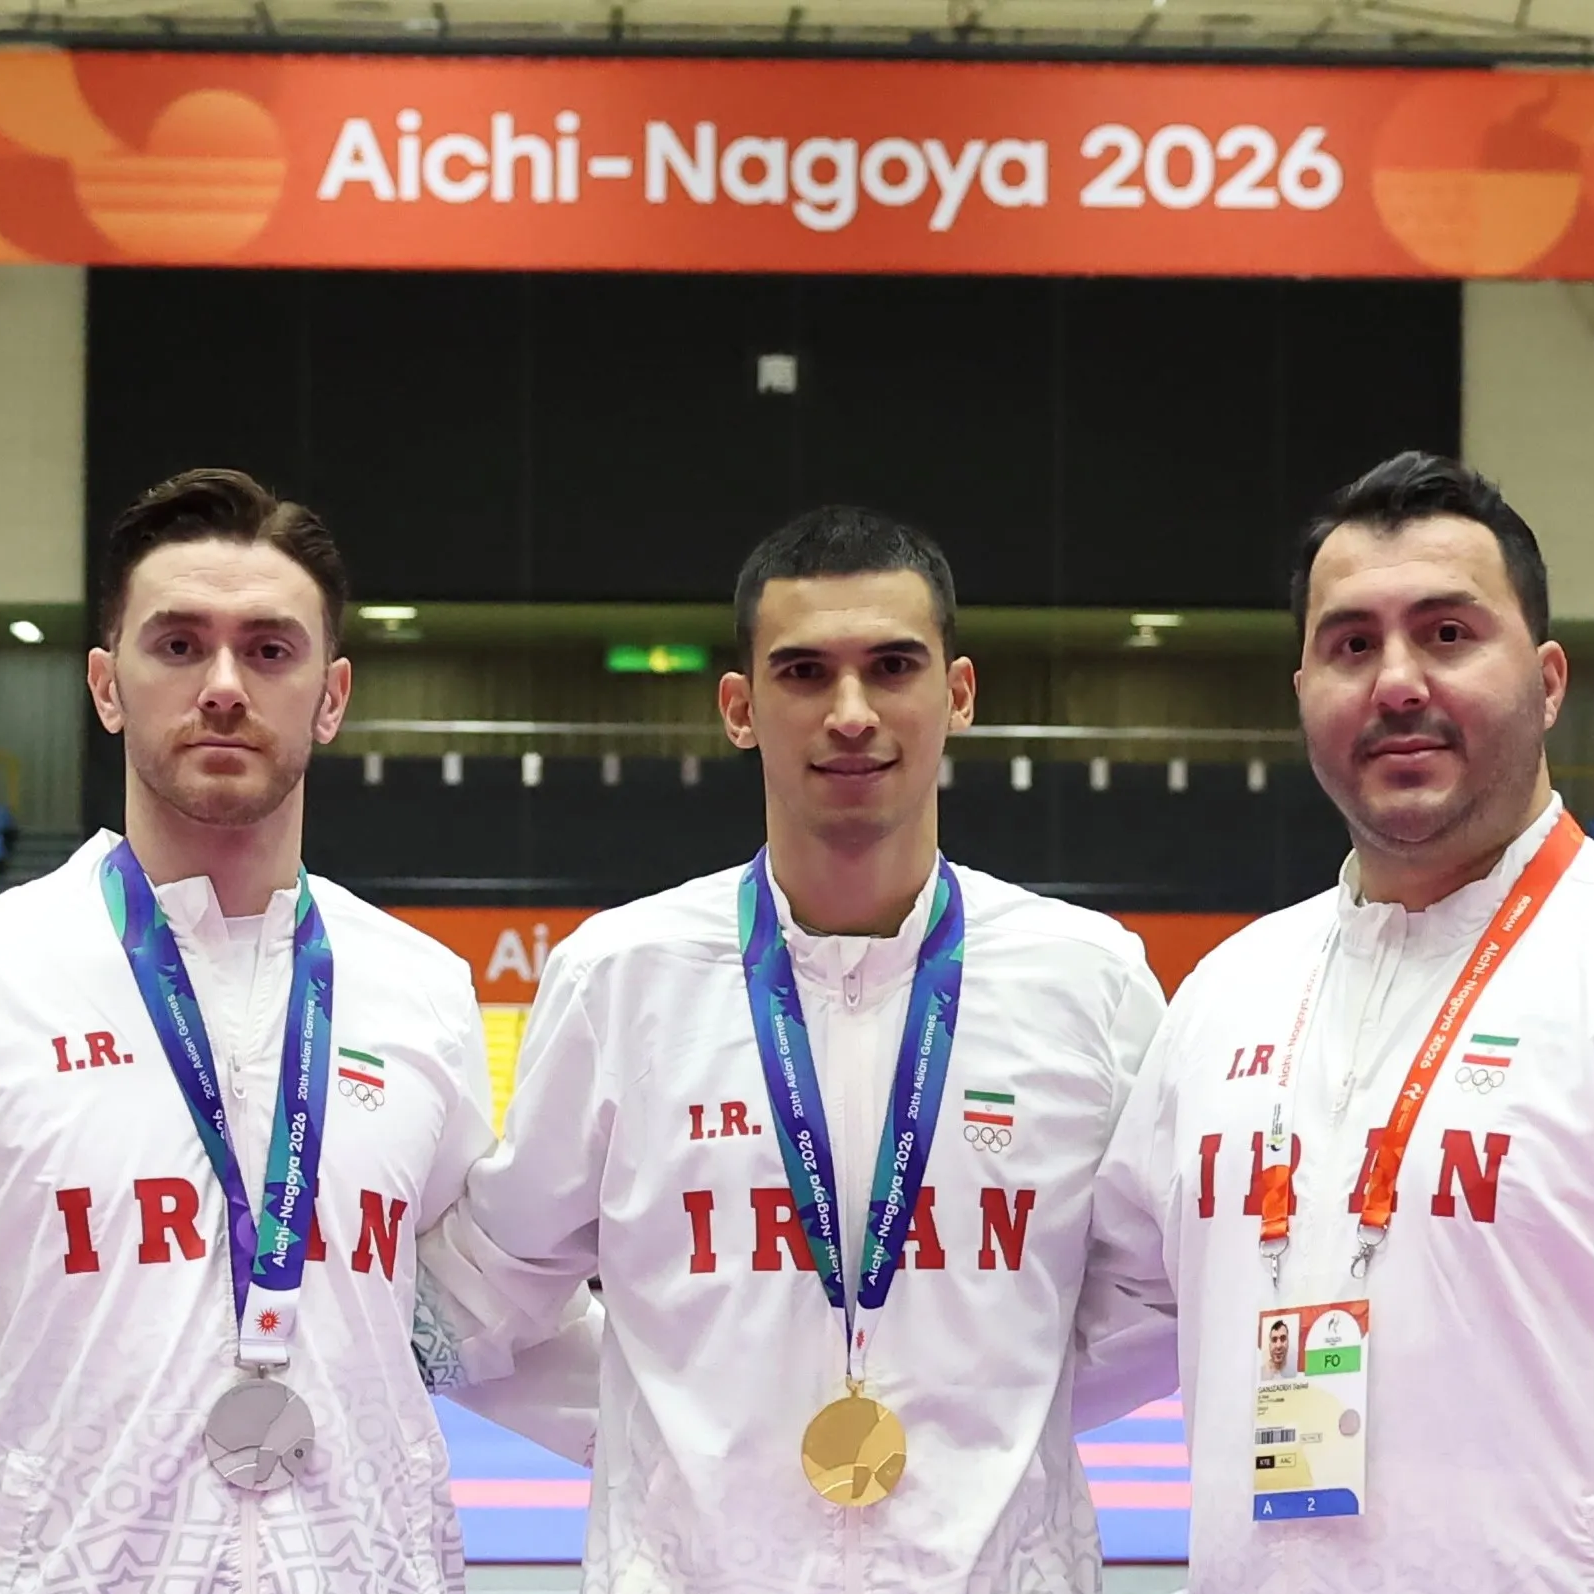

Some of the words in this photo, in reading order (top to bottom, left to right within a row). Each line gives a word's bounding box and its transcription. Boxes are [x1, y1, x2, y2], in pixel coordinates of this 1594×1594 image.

[318, 108, 1048, 231] Aichi-Nagoya
[1079, 124, 1343, 209] 2026
[1439, 940, 1501, 1032] Aichi-Nagoya
[167, 994, 187, 1038] Games
[305, 1000, 316, 1037] Games
[774, 1014, 790, 1055] Games
[51, 1031, 134, 1073] I.R.
[184, 1036, 204, 1071] Asian
[920, 1014, 938, 1056] Games
[1419, 1034, 1446, 1070] 2026
[300, 1037, 312, 1073] Asian
[782, 1056, 797, 1089] Asian
[913, 1056, 929, 1090] Asian
[196, 1068, 216, 1100] 20th
[297, 1074, 308, 1101] 20th
[688, 1100, 763, 1141] I.R.
[787, 1091, 804, 1120] 20th
[907, 1090, 922, 1120] 20th
[799, 1129, 818, 1171] 2026
[272, 1156, 301, 1268] Aichi-Nagoya
[288, 1111, 307, 1153] 2026
[867, 1173, 904, 1286] Aichi-Nagoya
[893, 1130, 915, 1172] 2026
[806, 1173, 842, 1285] Aichi-Nagoya
[1323, 1354, 1341, 1369] FO
[1262, 1500, 1273, 1515] A
[1307, 1498, 1316, 1512] 2
